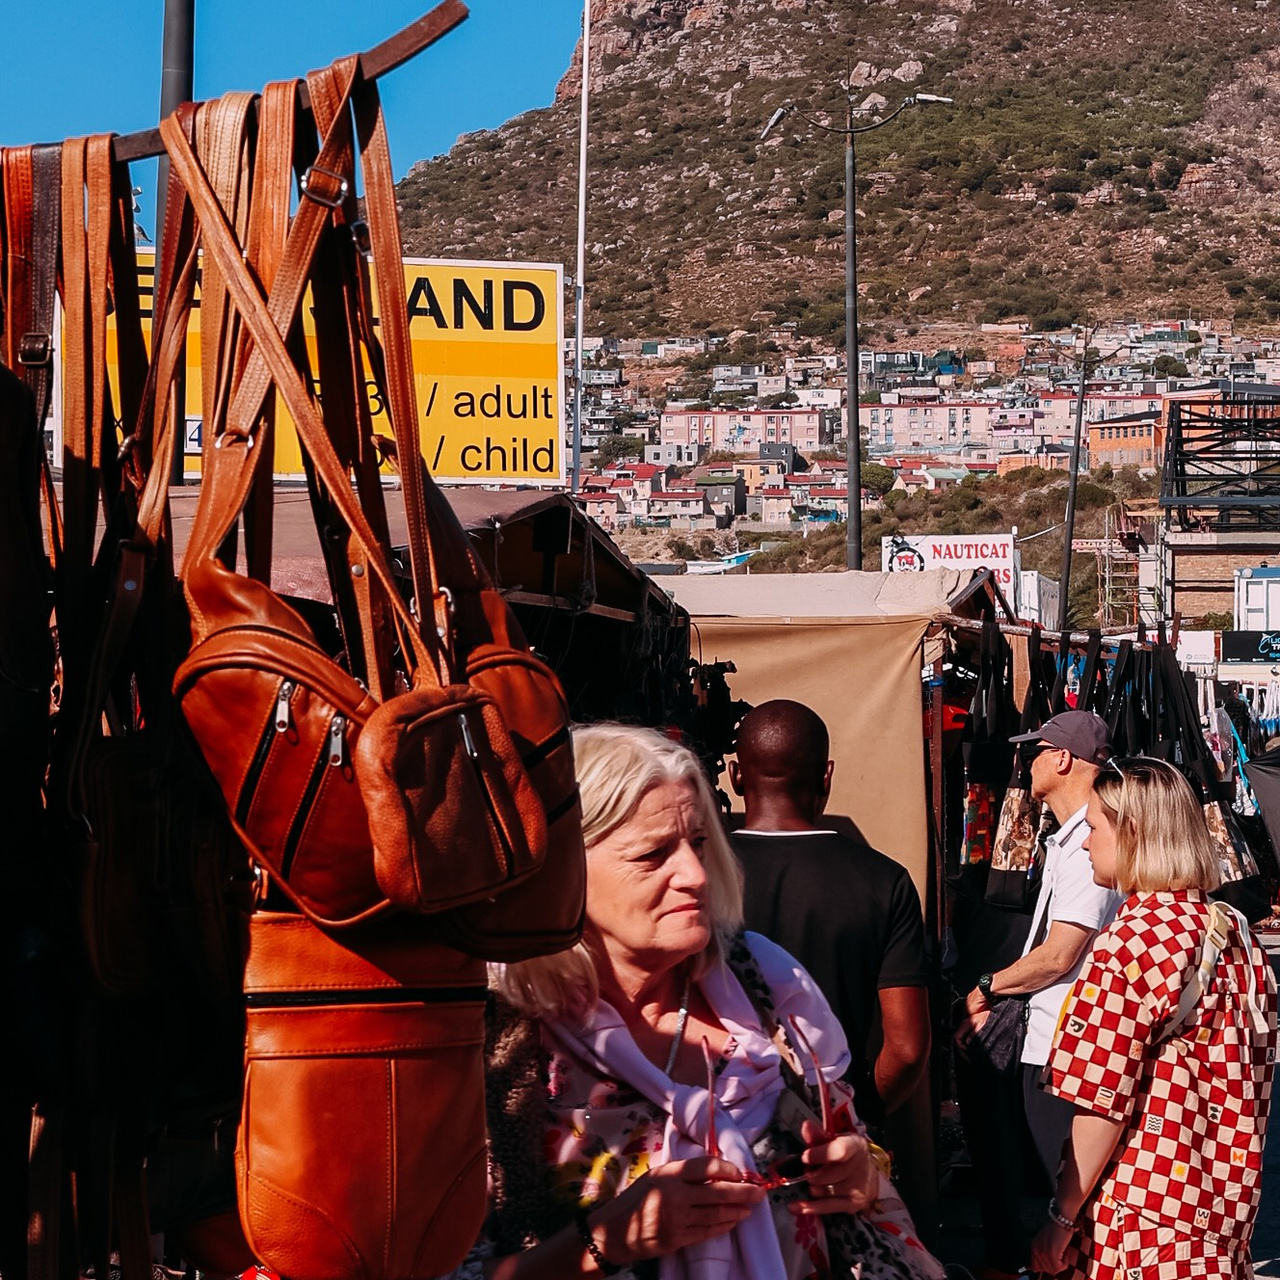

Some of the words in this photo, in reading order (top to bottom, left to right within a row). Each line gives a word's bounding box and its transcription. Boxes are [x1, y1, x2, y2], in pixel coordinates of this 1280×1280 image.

[453, 384, 553, 419] adult
[460, 436, 555, 473] child
[931, 543, 1009, 560] NAUTICAT
